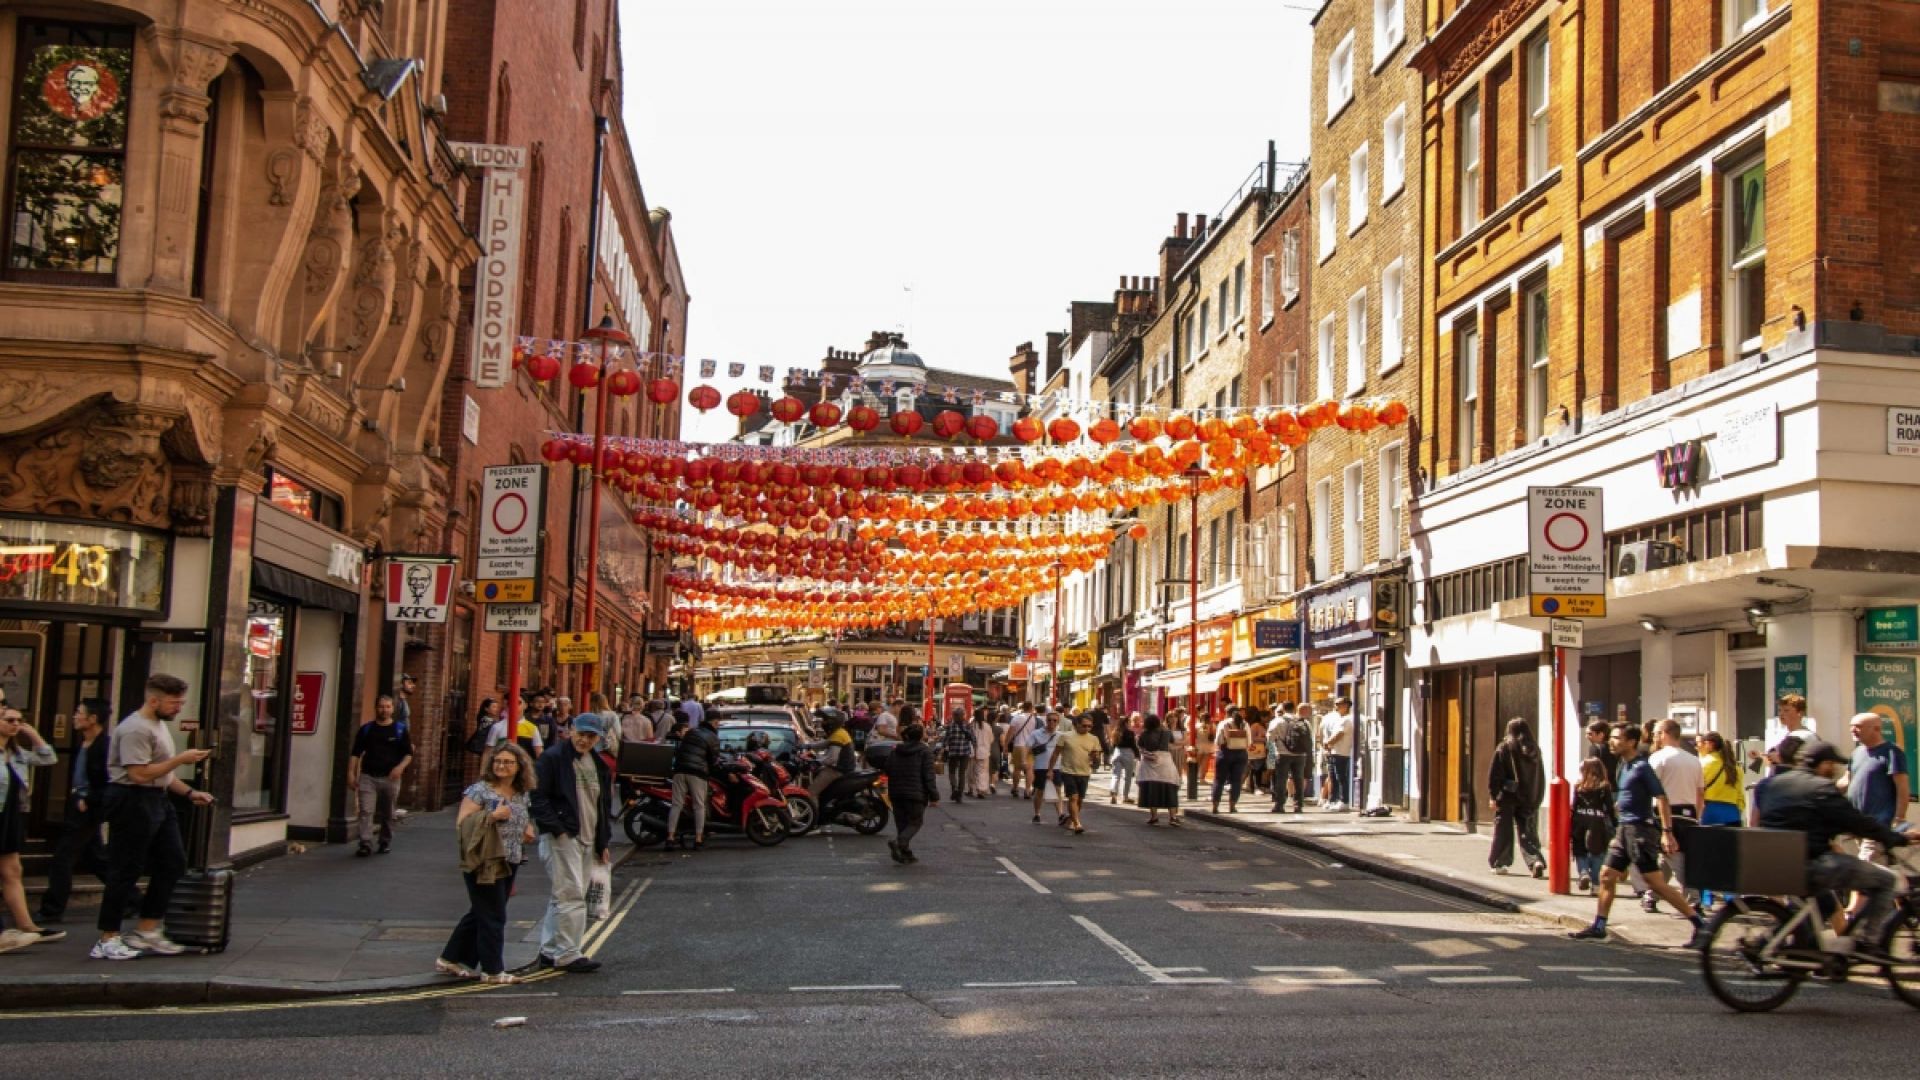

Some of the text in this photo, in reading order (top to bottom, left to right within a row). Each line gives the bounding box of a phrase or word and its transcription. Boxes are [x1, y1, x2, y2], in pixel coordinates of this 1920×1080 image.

[455, 146, 520, 165] ODON
[481, 178, 513, 380] HIPPODROME
[489, 467, 537, 476] PEDESTRIAN
[495, 477, 529, 490] ZONE
[1535, 489, 1596, 497] PEDESTRIAN
[1544, 498, 1587, 509] ZONE
[489, 537, 499, 545] No
[504, 546, 534, 555] Midnight
[50, 543, 109, 587] 43
[490, 560, 513, 568] Except
[1563, 563, 1601, 572] Midnight
[395, 606, 438, 620] KFC
[491, 606, 538, 618] Except for
[497, 619, 528, 628] access
[1864, 660, 1908, 673] bureau
[1878, 674, 1895, 686] de
[1863, 687, 1910, 701] change
